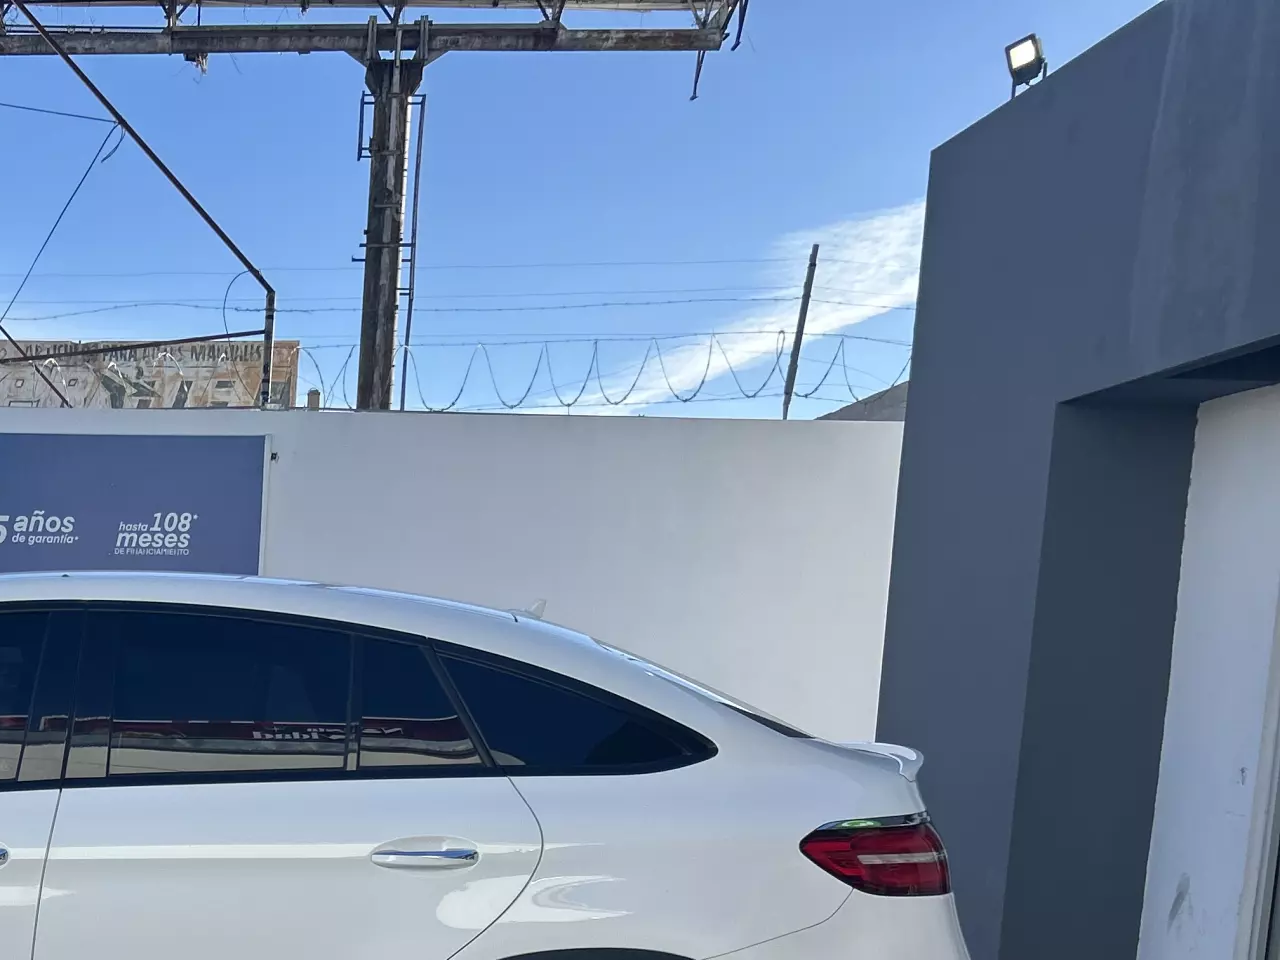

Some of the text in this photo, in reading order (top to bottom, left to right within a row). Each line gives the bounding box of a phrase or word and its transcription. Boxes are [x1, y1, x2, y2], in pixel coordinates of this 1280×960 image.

[13, 509, 76, 533] años
[118, 520, 148, 531] hasta
[11, 533, 26, 543] de
[115, 532, 191, 548] meses
